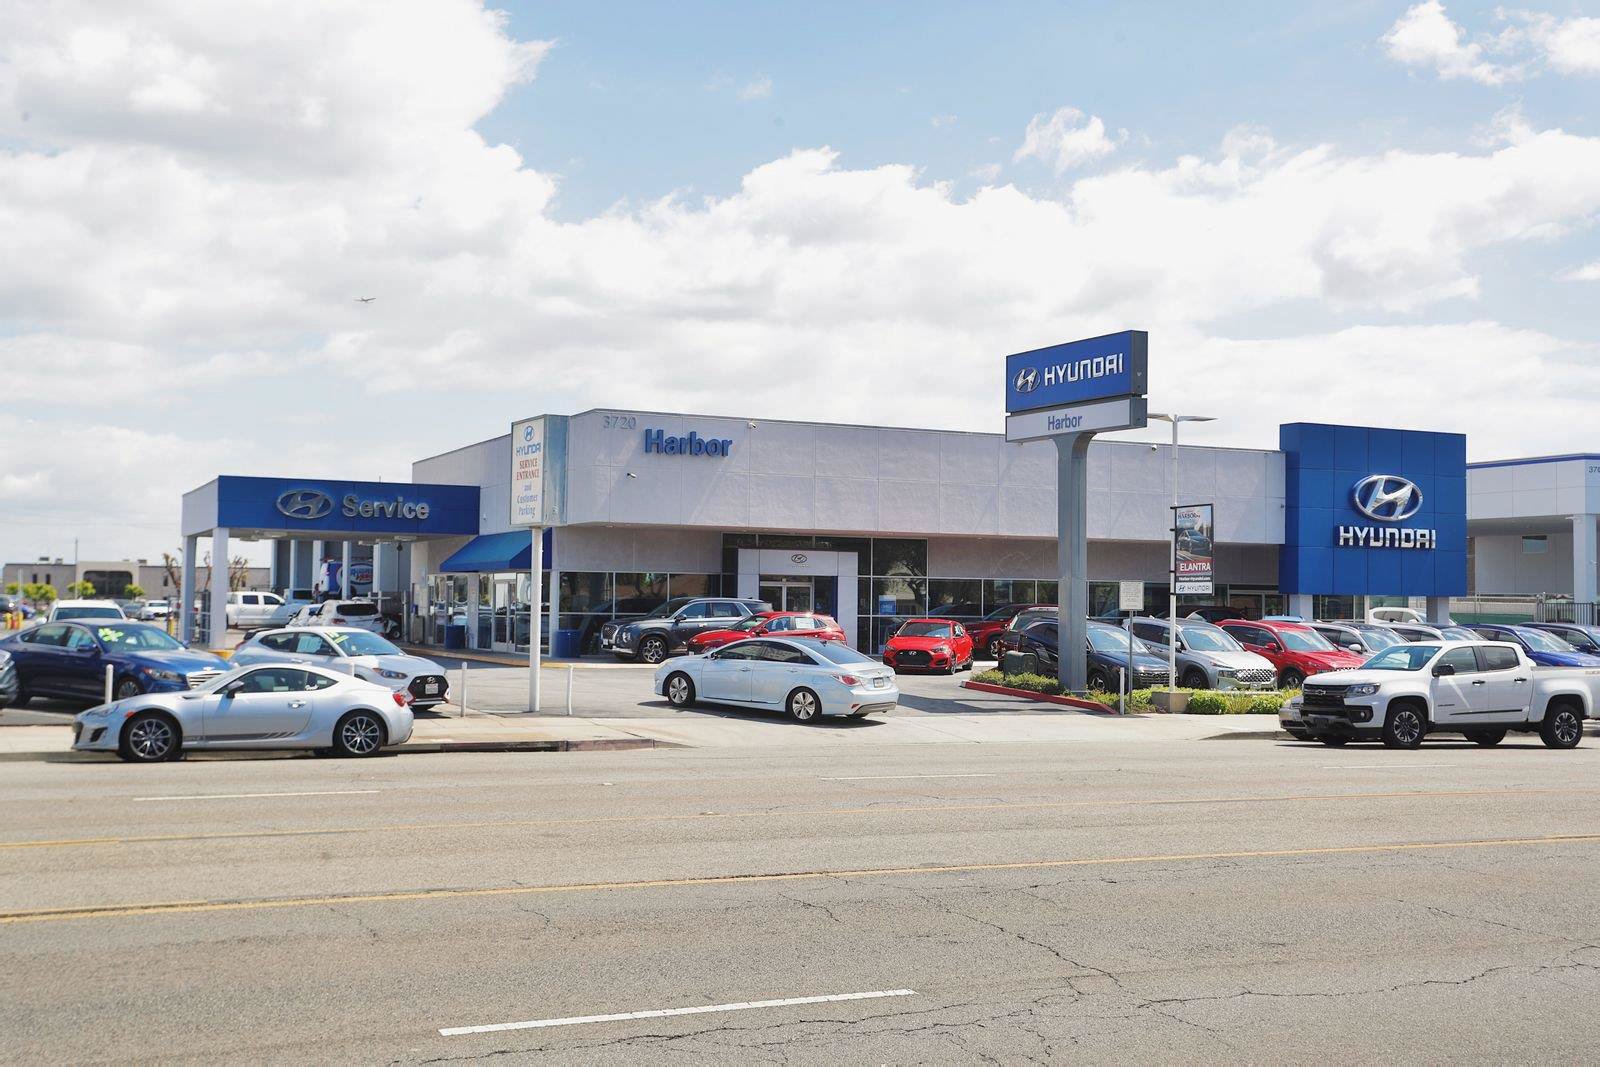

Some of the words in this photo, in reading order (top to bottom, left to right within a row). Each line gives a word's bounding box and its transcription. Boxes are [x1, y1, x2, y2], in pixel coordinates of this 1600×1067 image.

[1044, 353, 1123, 386] HYUNDAI
[603, 415, 637, 430] 3720
[1048, 414, 1083, 431] Harbor
[516, 442, 541, 456] HYUNDAI
[644, 428, 733, 457] Harbor
[519, 458, 538, 470] SERVICE
[516, 469, 540, 481] ENTRANCE
[524, 484, 532, 492] and
[342, 494, 430, 519] Service
[517, 494, 538, 504] Customer
[518, 504, 536, 519] Parking
[1339, 525, 1437, 549] HYUNDAI
[1180, 562, 1211, 572] ELANTRA
